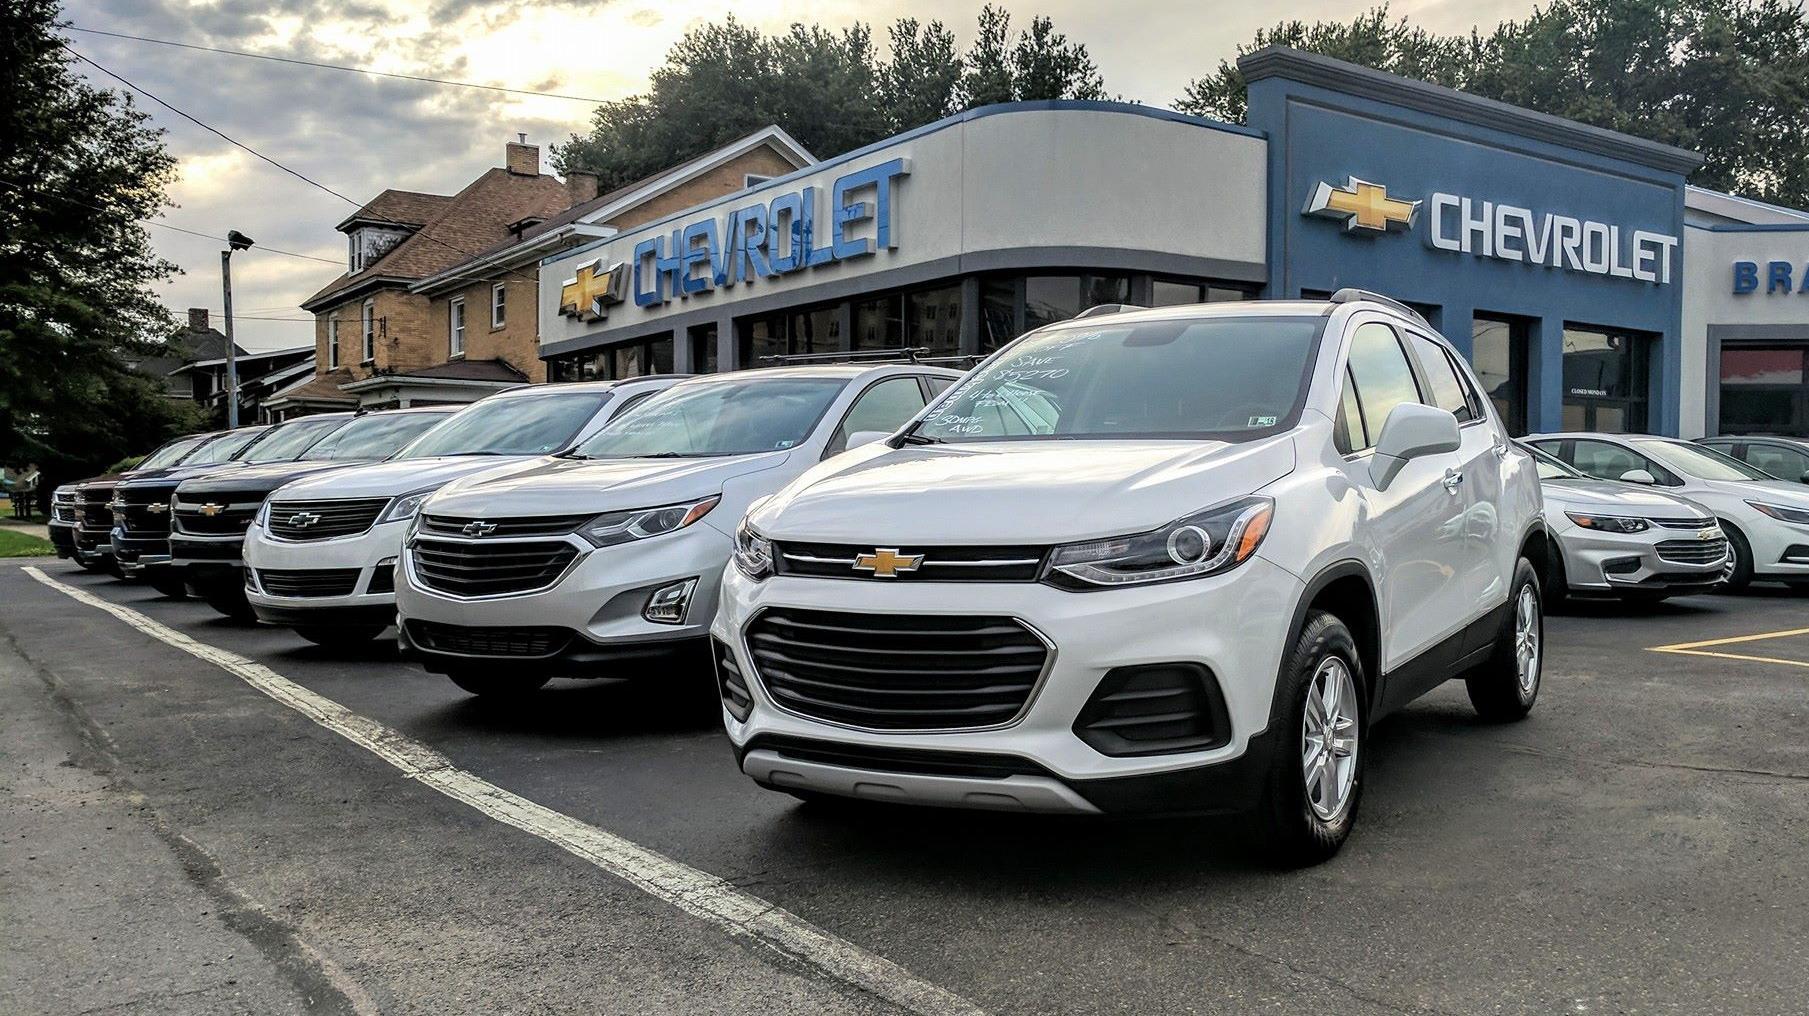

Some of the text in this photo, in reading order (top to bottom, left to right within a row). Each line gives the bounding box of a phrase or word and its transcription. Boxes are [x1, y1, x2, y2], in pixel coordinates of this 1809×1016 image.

[634, 157, 910, 307] CHEVROLET
[1430, 192, 1677, 284] CHEVROLET
[948, 424, 983, 433] AWD
